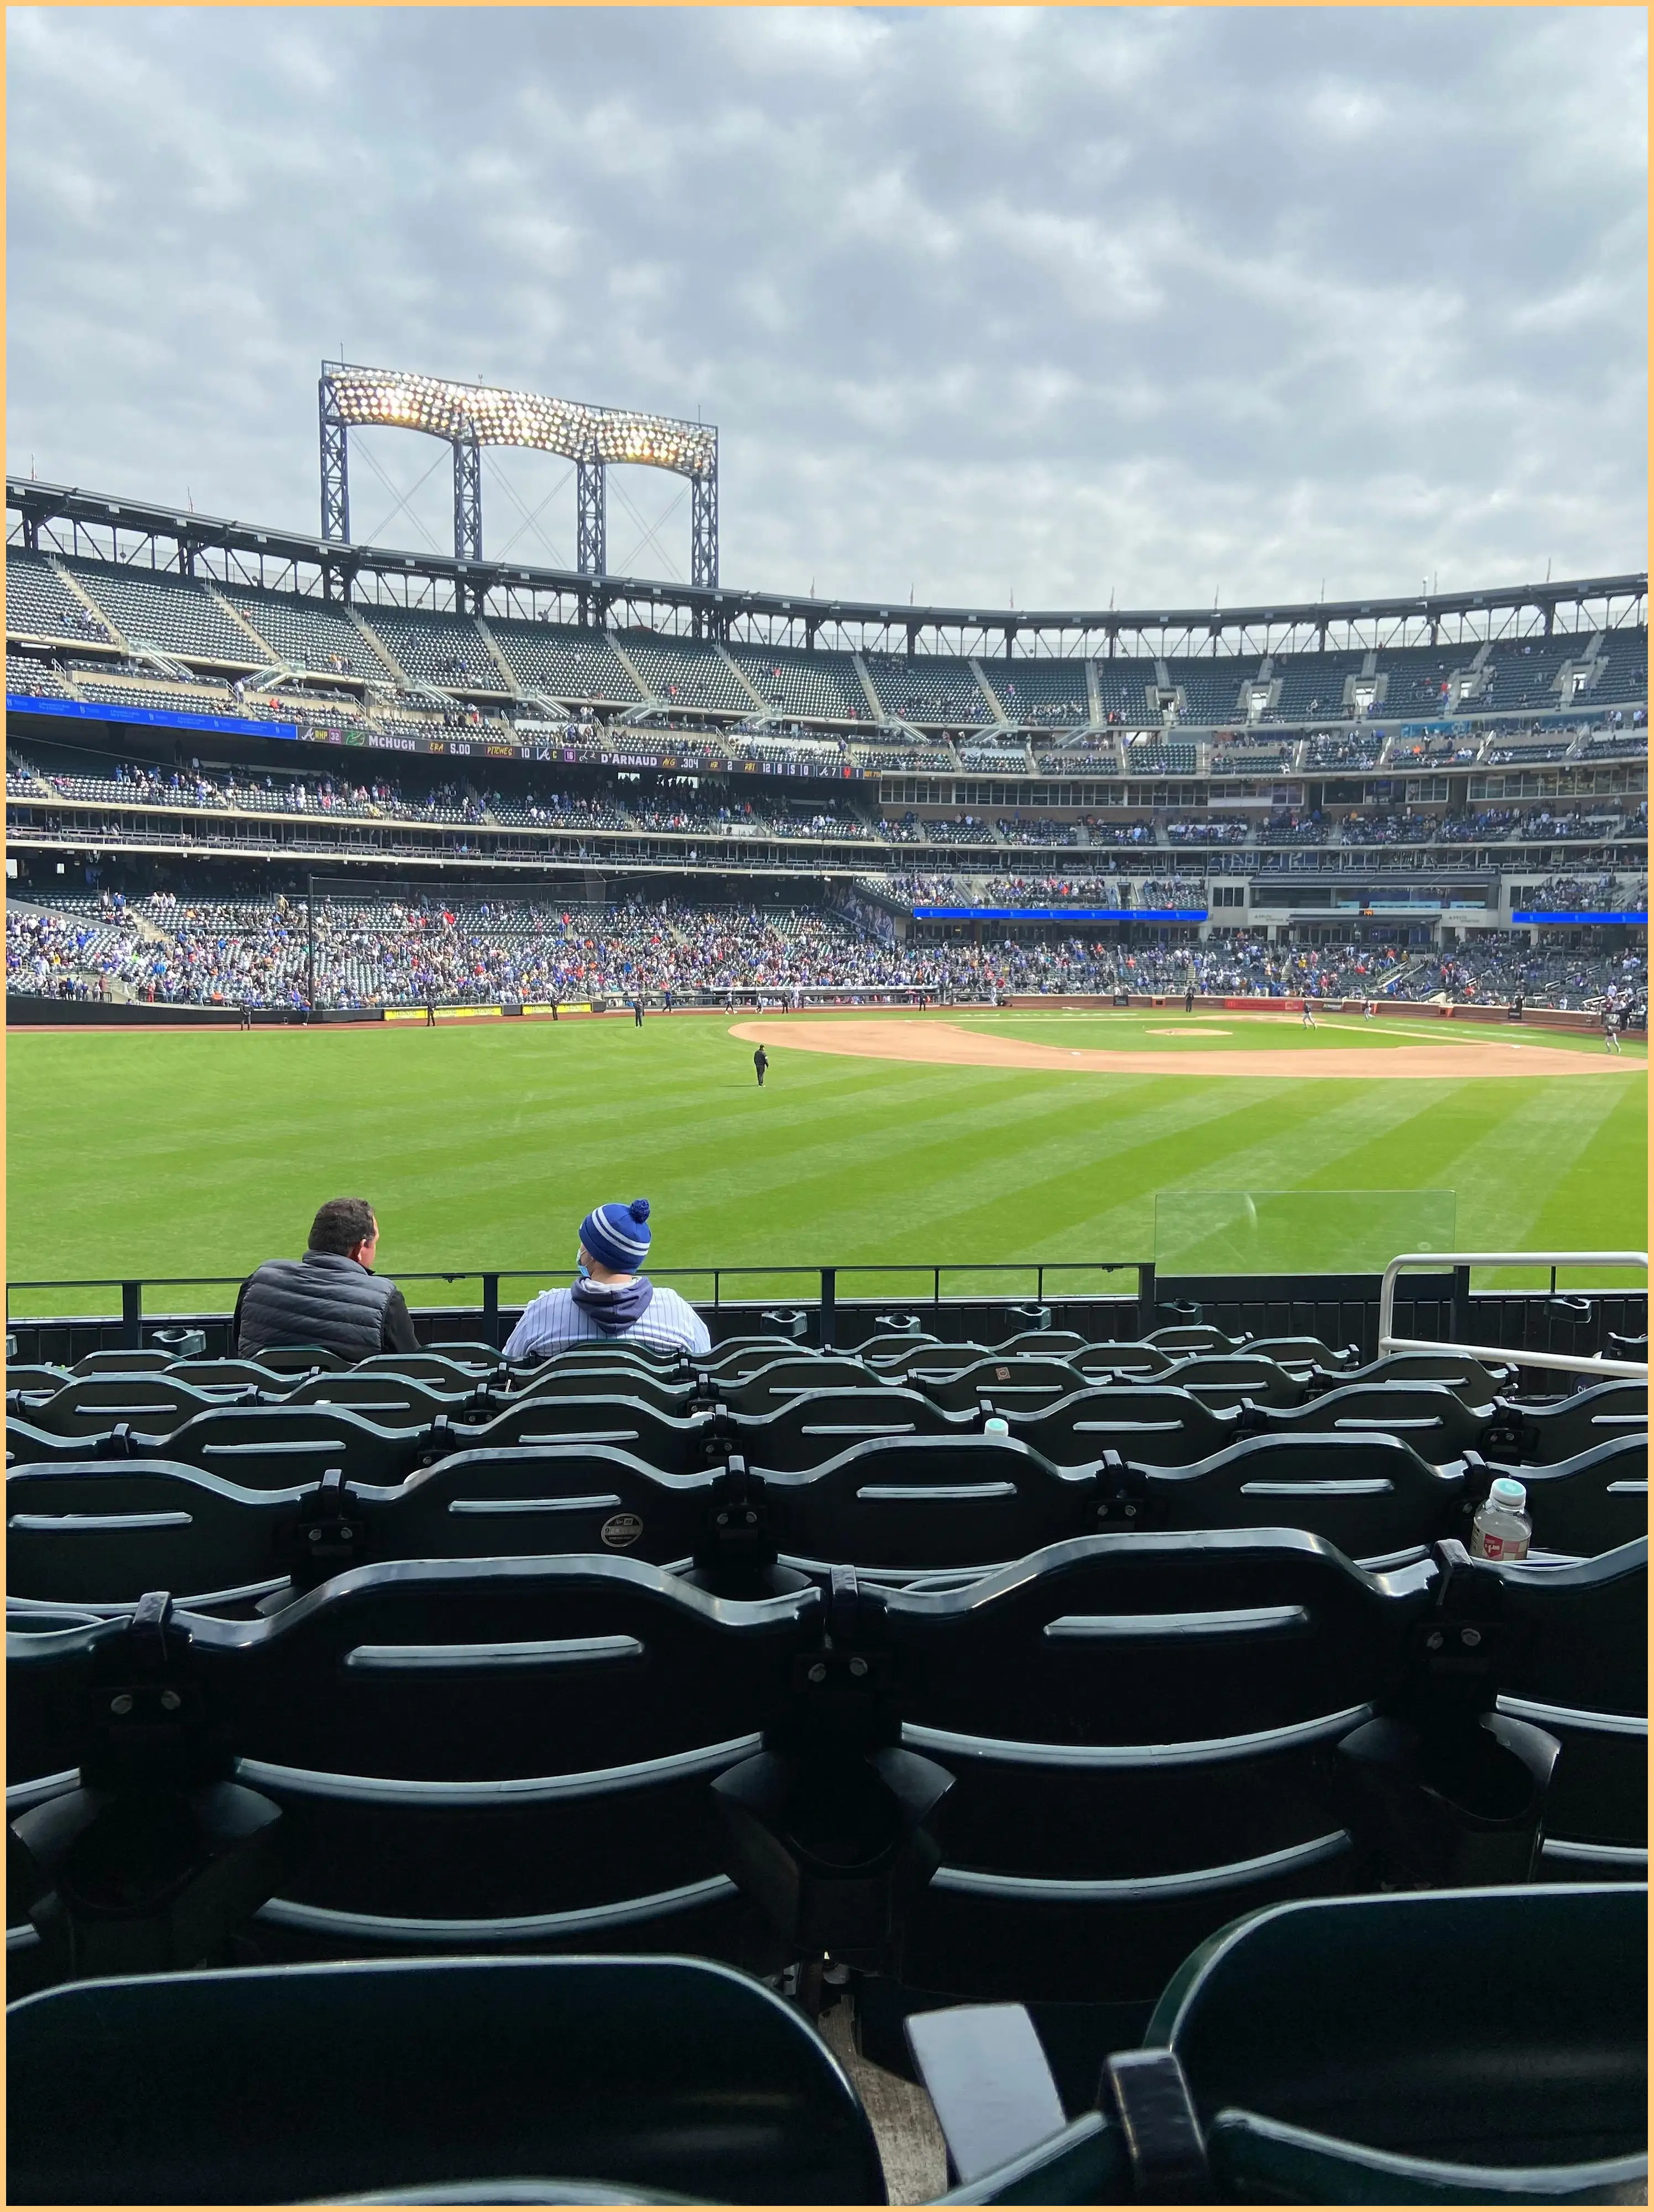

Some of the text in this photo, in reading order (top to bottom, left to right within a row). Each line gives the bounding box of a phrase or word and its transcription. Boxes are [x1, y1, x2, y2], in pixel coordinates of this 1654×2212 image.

[315, 730, 327, 740] RHP
[331, 732, 340, 741] 32
[429, 742, 444, 752] ERA
[450, 743, 471, 755] 5.00
[487, 746, 513, 756] PITCHES
[521, 747, 530, 758] 10
[552, 749, 557, 758] C
[681, 758, 699, 769] .304
[727, 761, 733, 771] 2
[763, 763, 770, 773] 12
[790, 764, 796, 774] S
[832, 767, 837, 777] 7
